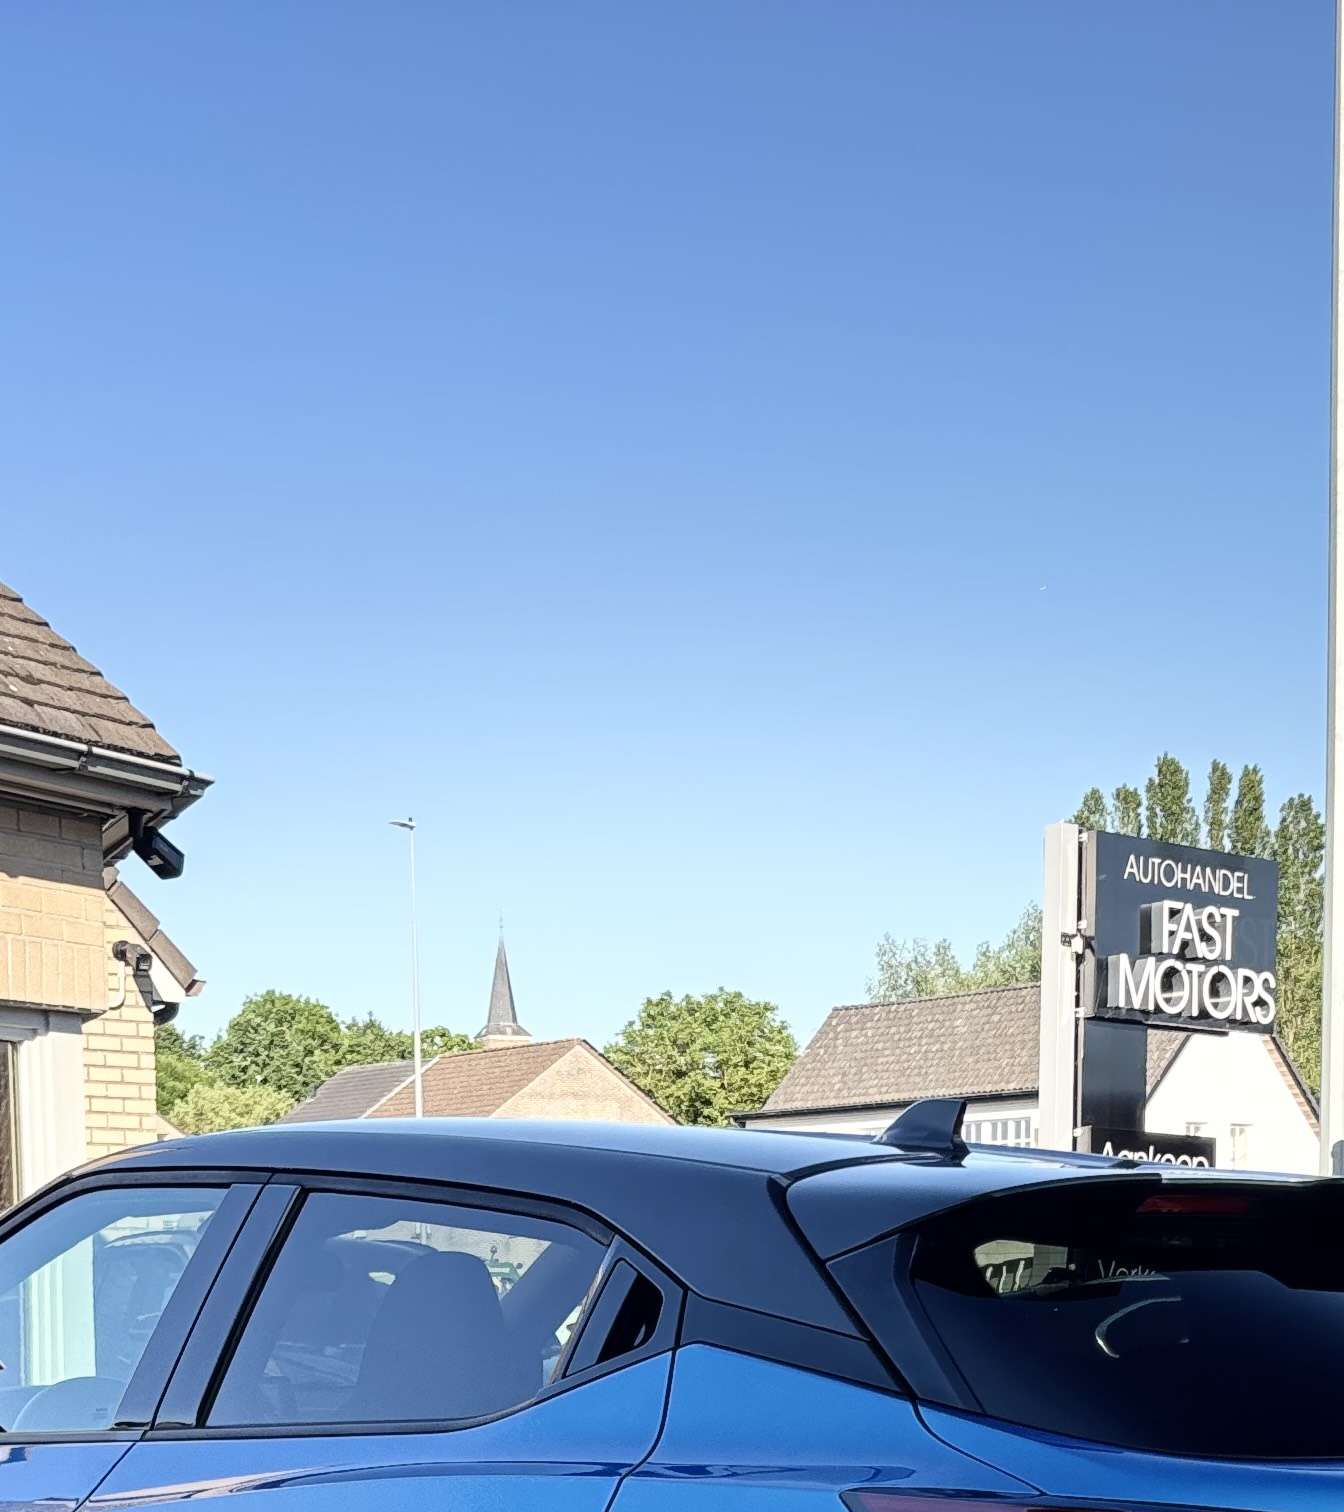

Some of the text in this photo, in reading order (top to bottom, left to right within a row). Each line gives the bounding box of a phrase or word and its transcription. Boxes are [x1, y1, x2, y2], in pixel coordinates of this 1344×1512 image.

[1123, 854, 1255, 900] AUTOHANDEL
[1161, 899, 1240, 961] FAST
[1118, 953, 1276, 1025] MOTORS
